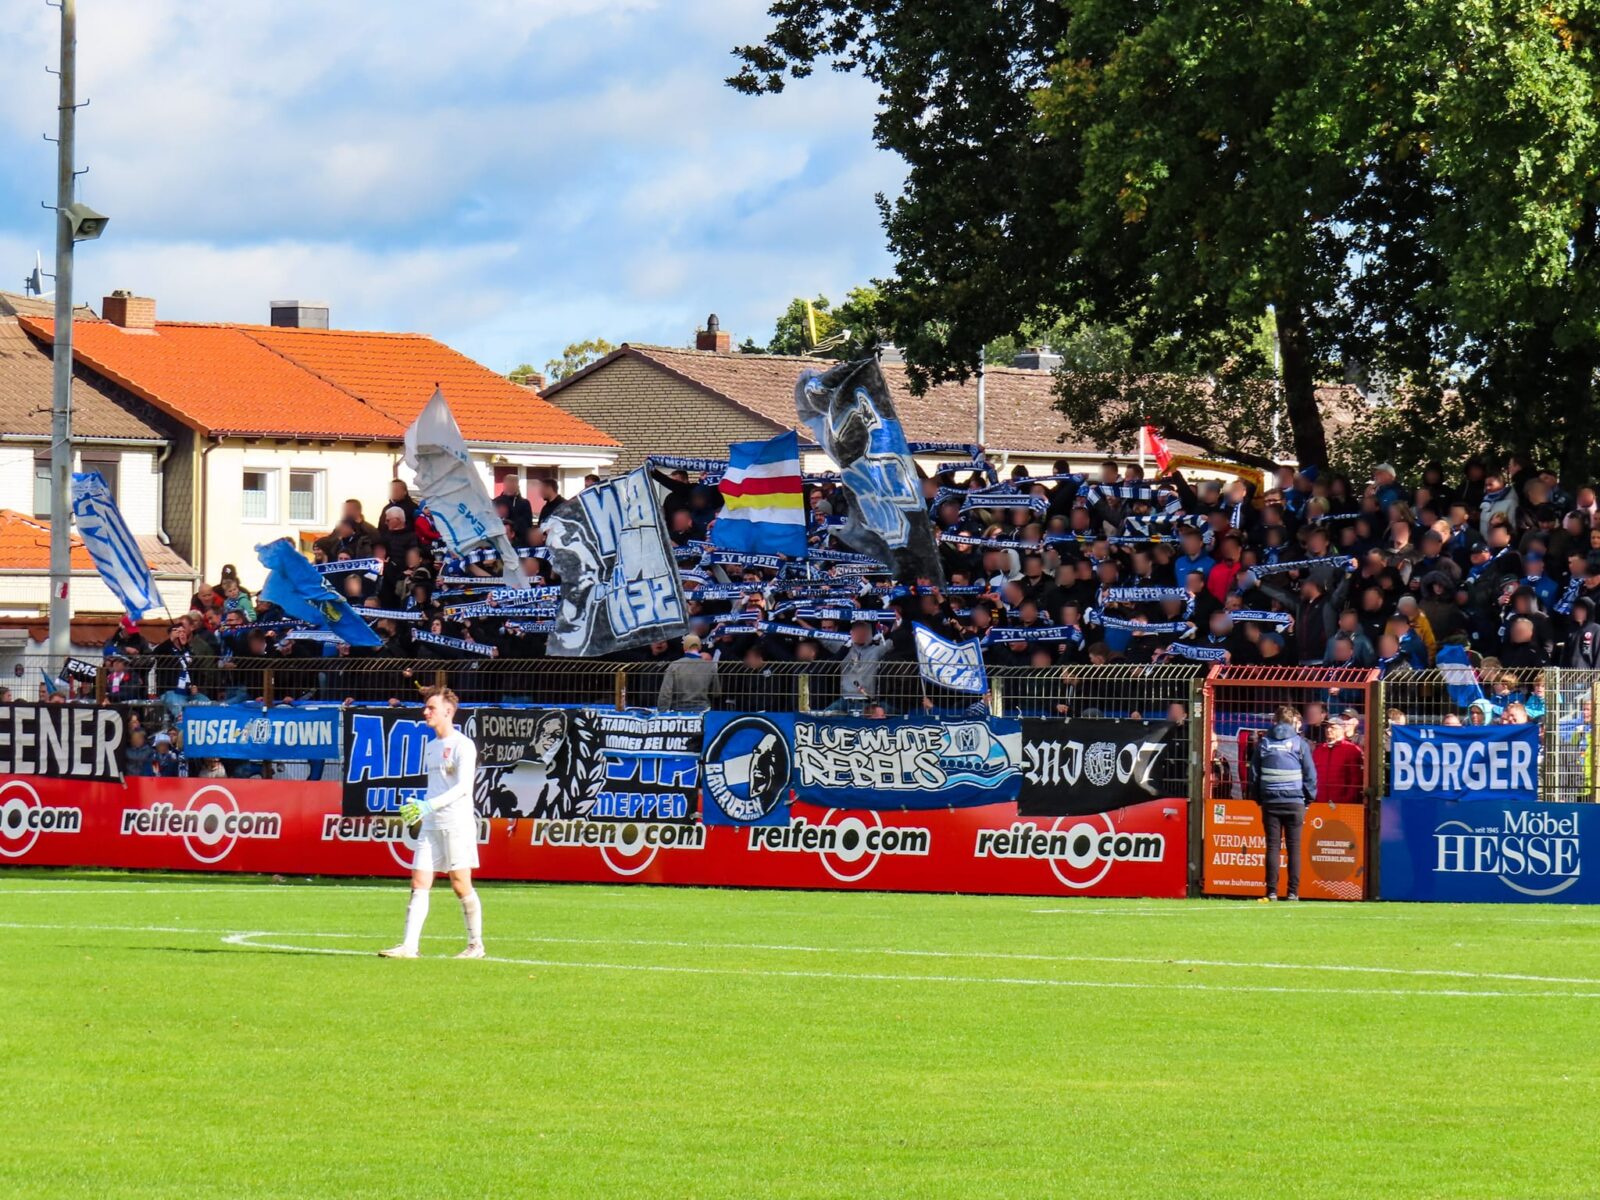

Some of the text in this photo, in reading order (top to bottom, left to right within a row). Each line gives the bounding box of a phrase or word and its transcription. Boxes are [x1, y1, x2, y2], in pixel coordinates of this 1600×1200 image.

[721, 554, 778, 566] SV MEPPEN
[491, 586, 561, 600] SPORTVER
[1109, 588, 1124, 598] SV
[1124, 587, 1161, 598] MEPPEN
[68, 659, 97, 677] EMS
[187, 719, 332, 746] FUSEL TOWN
[482, 715, 534, 738] FOREVER
[796, 723, 943, 752] BLUE WHITE
[605, 735, 642, 750] IMMER
[644, 736, 663, 750] BEI
[800, 749, 947, 790] REBELS
[1116, 742, 1167, 784] 07
[1393, 728, 1535, 792] BÖRGER
[591, 792, 688, 818] MEPPEN
[1502, 810, 1580, 835] Möbel
[1432, 834, 1581, 876] HESSE
